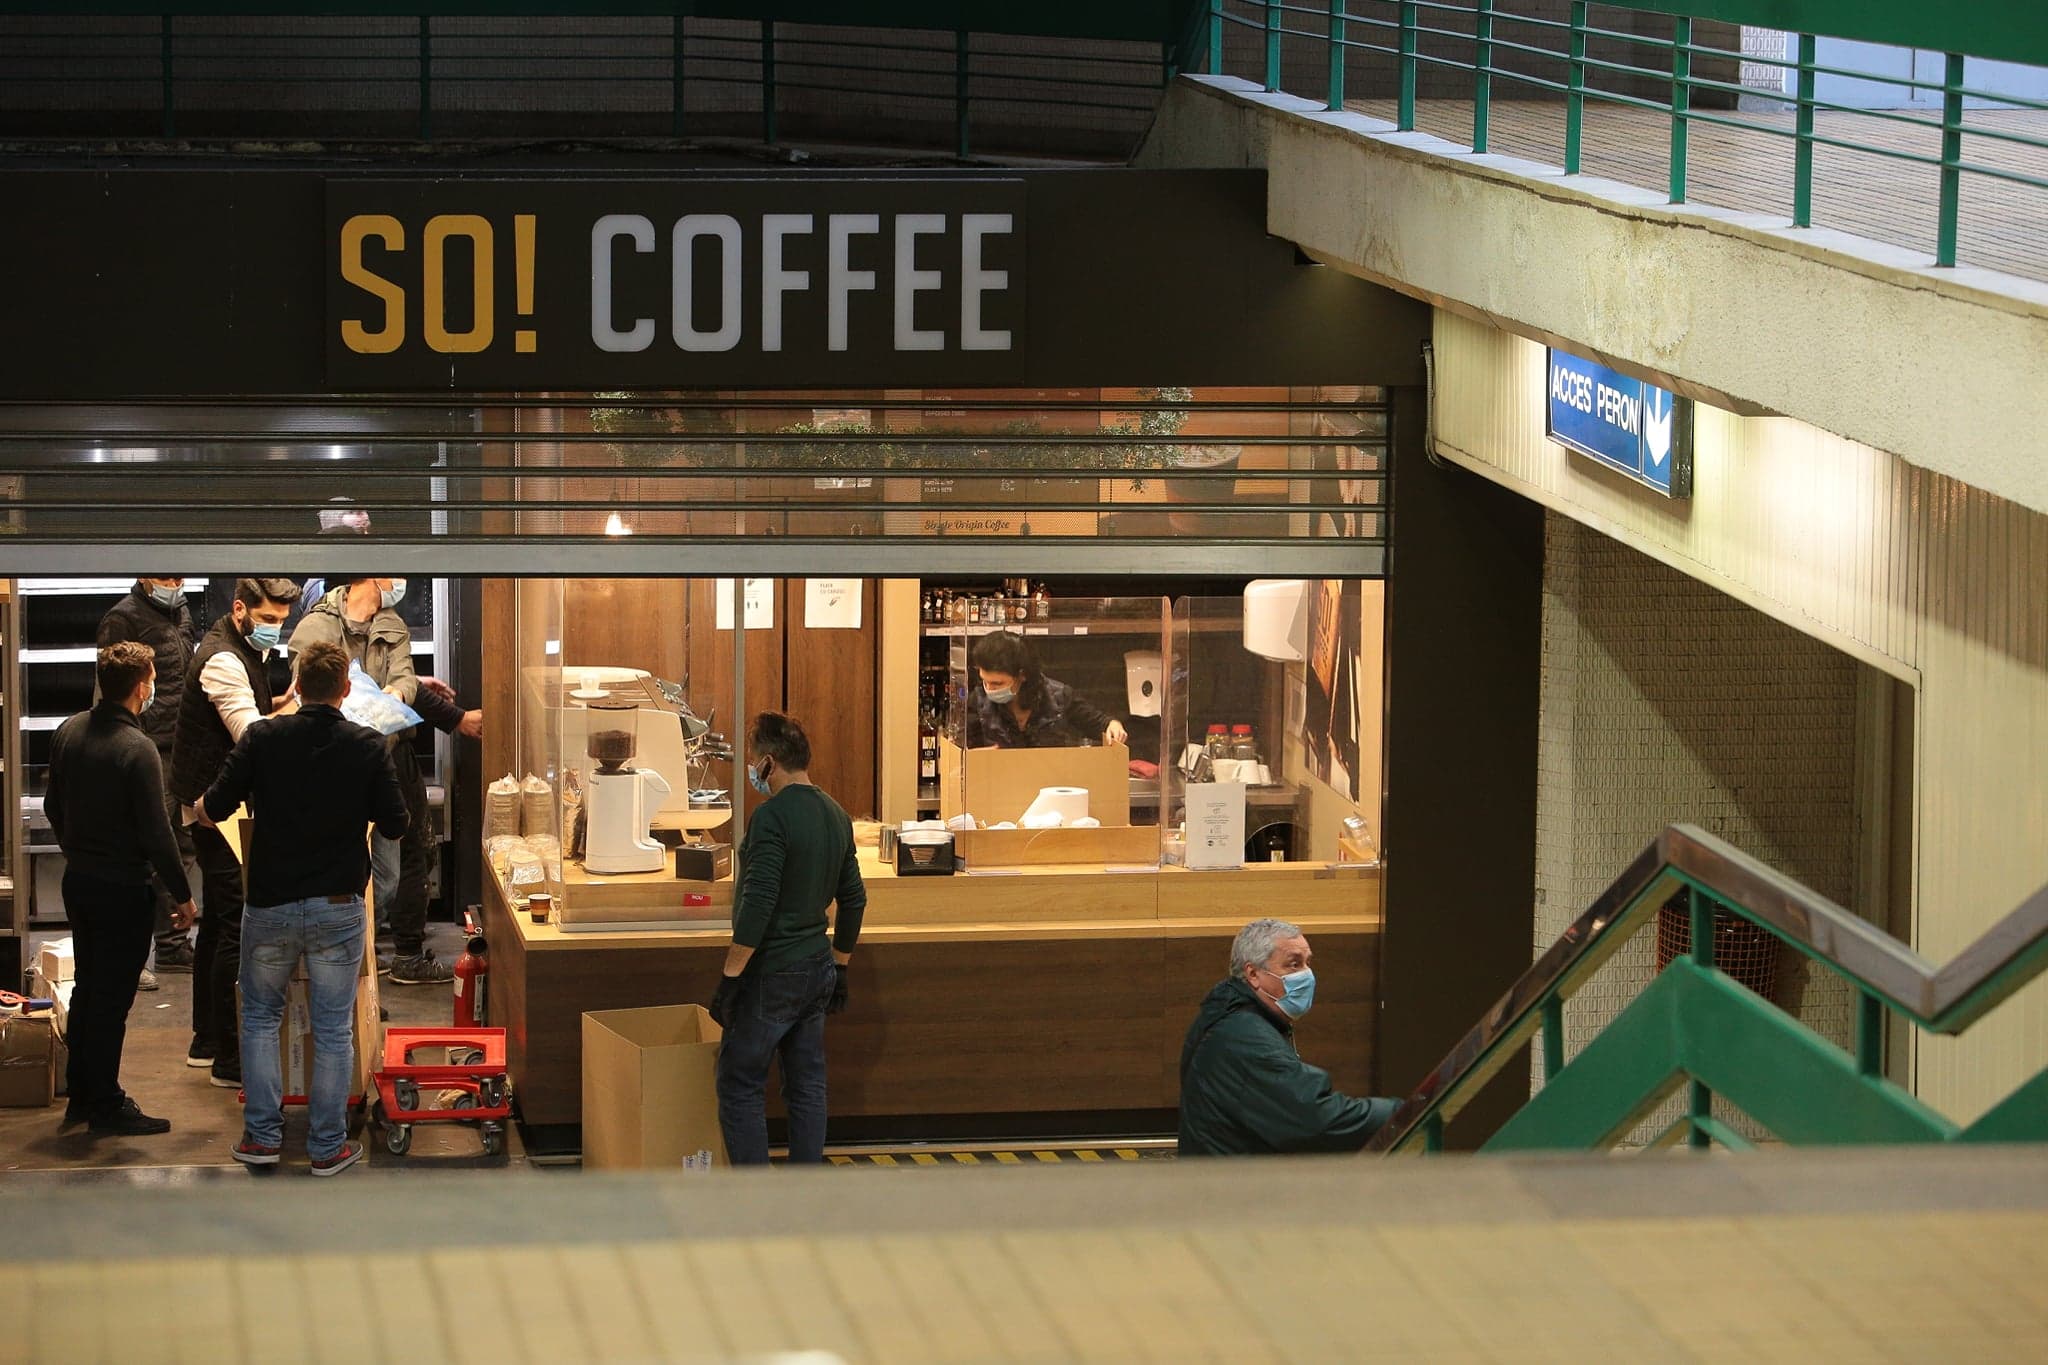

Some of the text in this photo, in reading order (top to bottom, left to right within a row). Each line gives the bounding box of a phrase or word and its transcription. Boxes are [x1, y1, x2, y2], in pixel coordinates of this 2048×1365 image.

[341, 214, 1012, 353] SO! COFFEE
[1551, 365, 1639, 436] ACCES PERON
[985, 519, 1010, 532] Coffee
